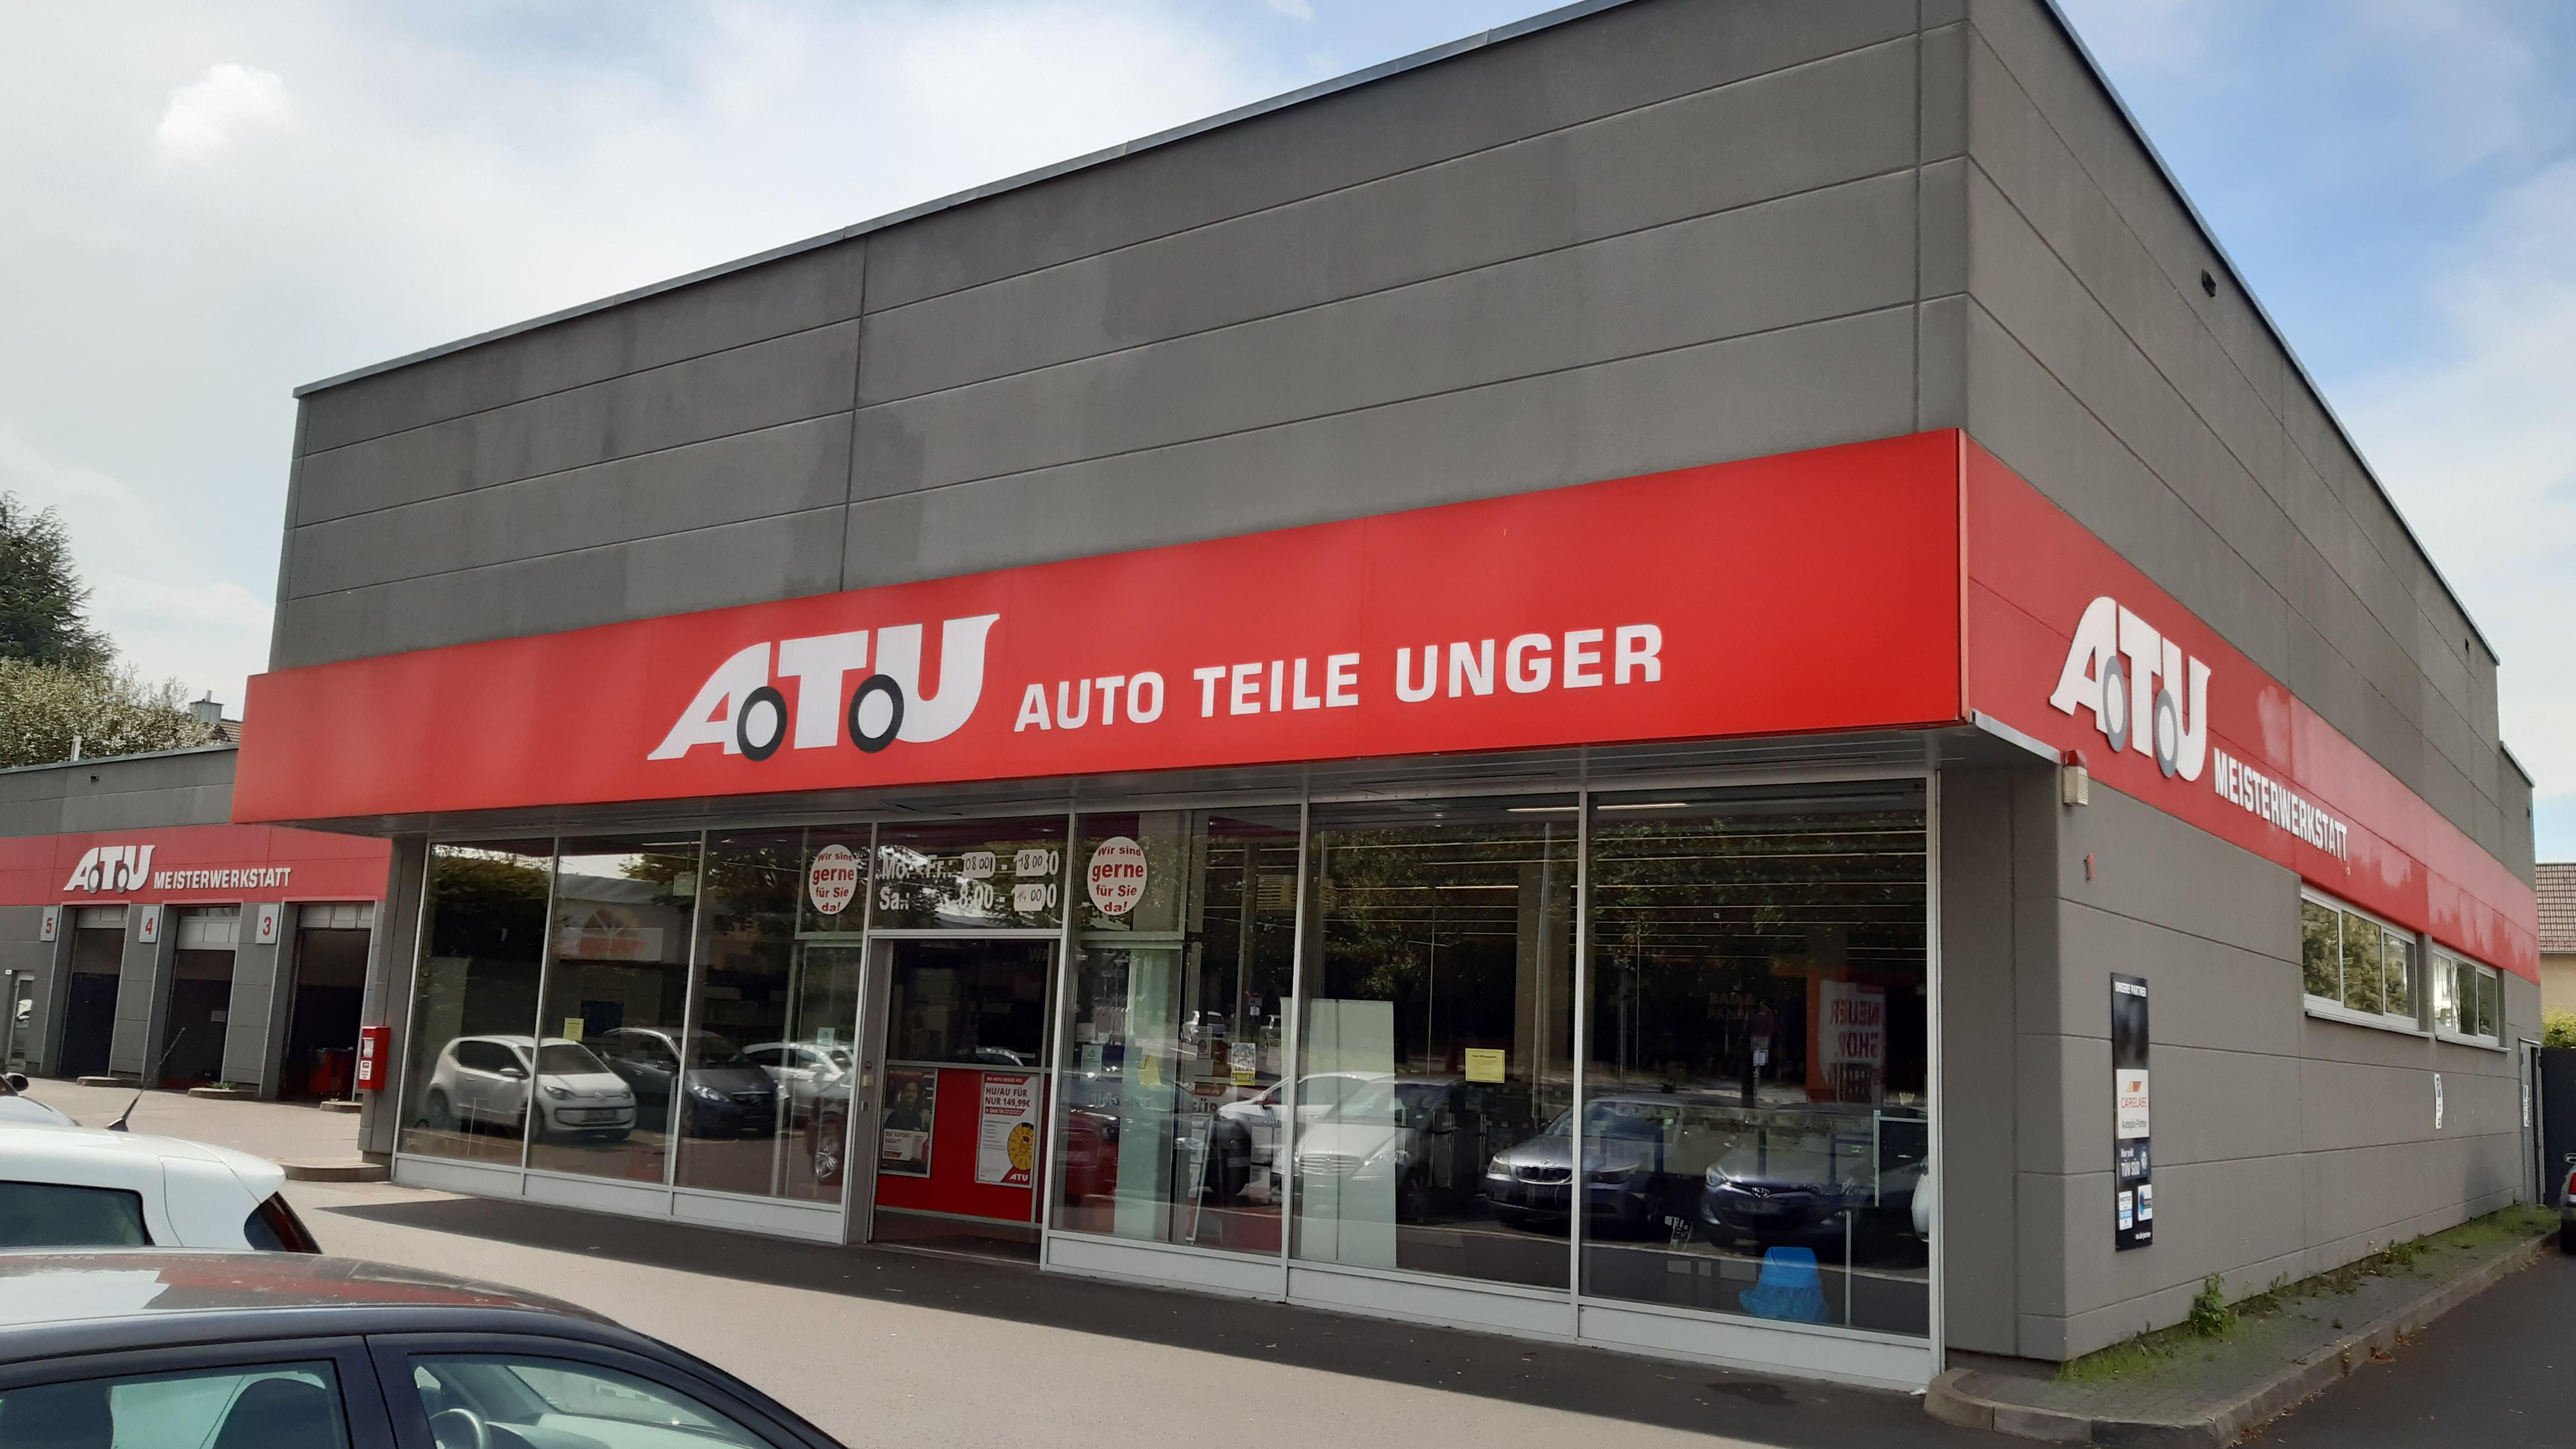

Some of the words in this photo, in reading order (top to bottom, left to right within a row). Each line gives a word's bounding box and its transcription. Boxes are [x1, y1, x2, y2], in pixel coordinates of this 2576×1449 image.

[1014, 671, 1164, 732] AUTO
[1193, 652, 1360, 718] TEILE
[1396, 623, 1662, 703] UNGER
[647, 614, 1000, 761] ATU
[2049, 596, 2211, 782] ATU
[2214, 747, 2347, 861] MEISTERWERKSTATT
[818, 853, 832, 861] Wir
[1098, 846, 1115, 856] Wir
[1119, 846, 1141, 856] sind
[63, 845, 155, 894] ATU
[813, 868, 854, 885] gerne
[1092, 864, 1144, 882] gerne
[154, 868, 291, 889] MEISTERWERKSTATT
[816, 887, 830, 898] für
[833, 887, 849, 898] Sie
[1096, 884, 1114, 897] für
[1117, 885, 1137, 897] Sie
[822, 902, 841, 912] da!
[1104, 901, 1128, 912] da!
[45, 917, 53, 934] 5
[145, 917, 154, 935] 4
[263, 916, 272, 936] 3
[1014, 1087, 1027, 1097] FÜR
[986, 1097, 1001, 1105] NUR
